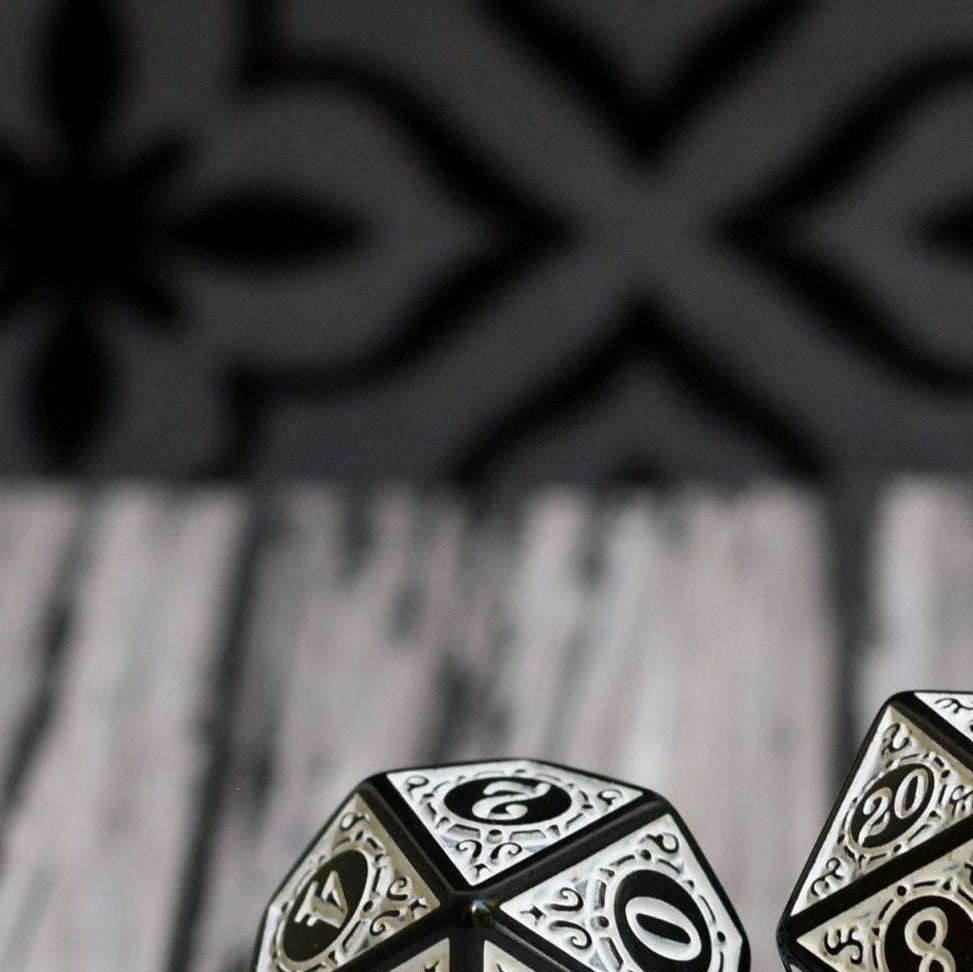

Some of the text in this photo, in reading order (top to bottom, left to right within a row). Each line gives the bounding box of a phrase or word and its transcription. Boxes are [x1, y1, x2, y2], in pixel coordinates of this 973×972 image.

[472, 779, 551, 821] 2
[857, 768, 931, 848] 20
[294, 870, 349, 929] 4
[625, 895, 702, 962] 0
